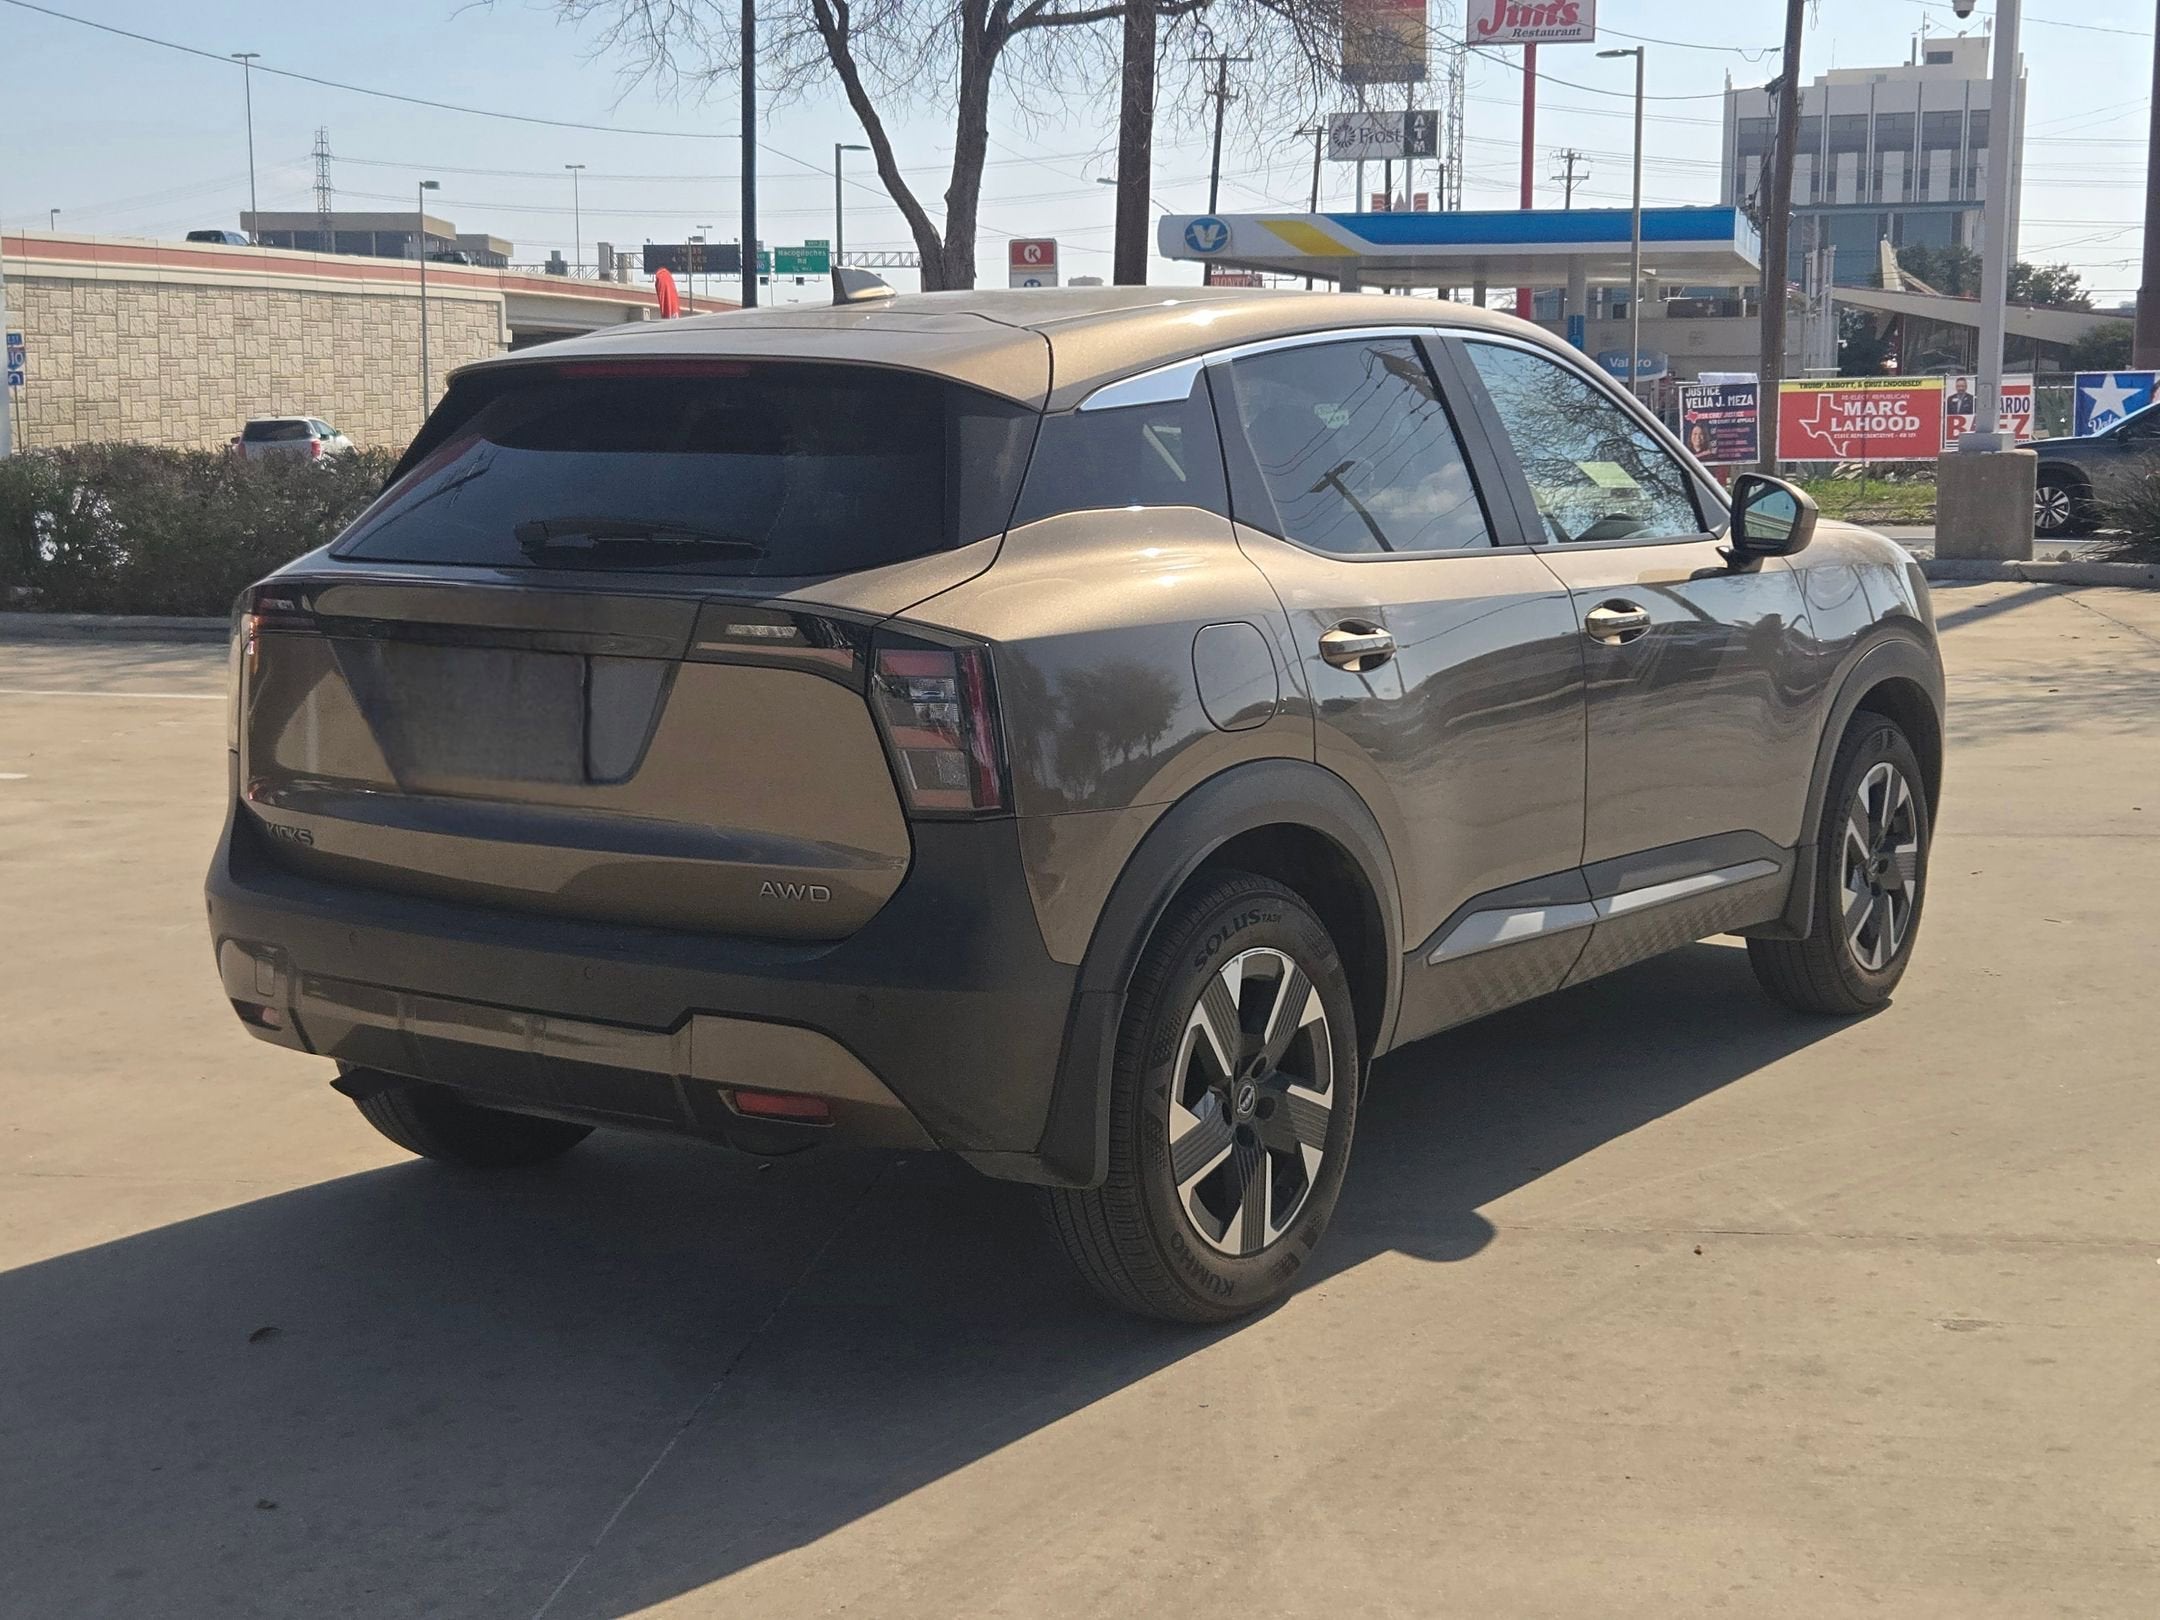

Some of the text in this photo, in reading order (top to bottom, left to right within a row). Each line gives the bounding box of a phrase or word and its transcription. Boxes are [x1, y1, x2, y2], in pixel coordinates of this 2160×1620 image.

[1512, 28, 1581, 38] Restaurant
[1359, 127, 1404, 144] Frost
[1413, 114, 1426, 152] ATM
[1609, 357, 1652, 367] Valro
[1685, 386, 1721, 397] JUSTICE
[1686, 394, 1754, 409] VELIA J. MEZA
[1843, 401, 1908, 416] MARC
[760, 881, 831, 902] AWD
[1194, 909, 1262, 971] SOLUS
[1170, 1231, 1235, 1297] KUMHO
